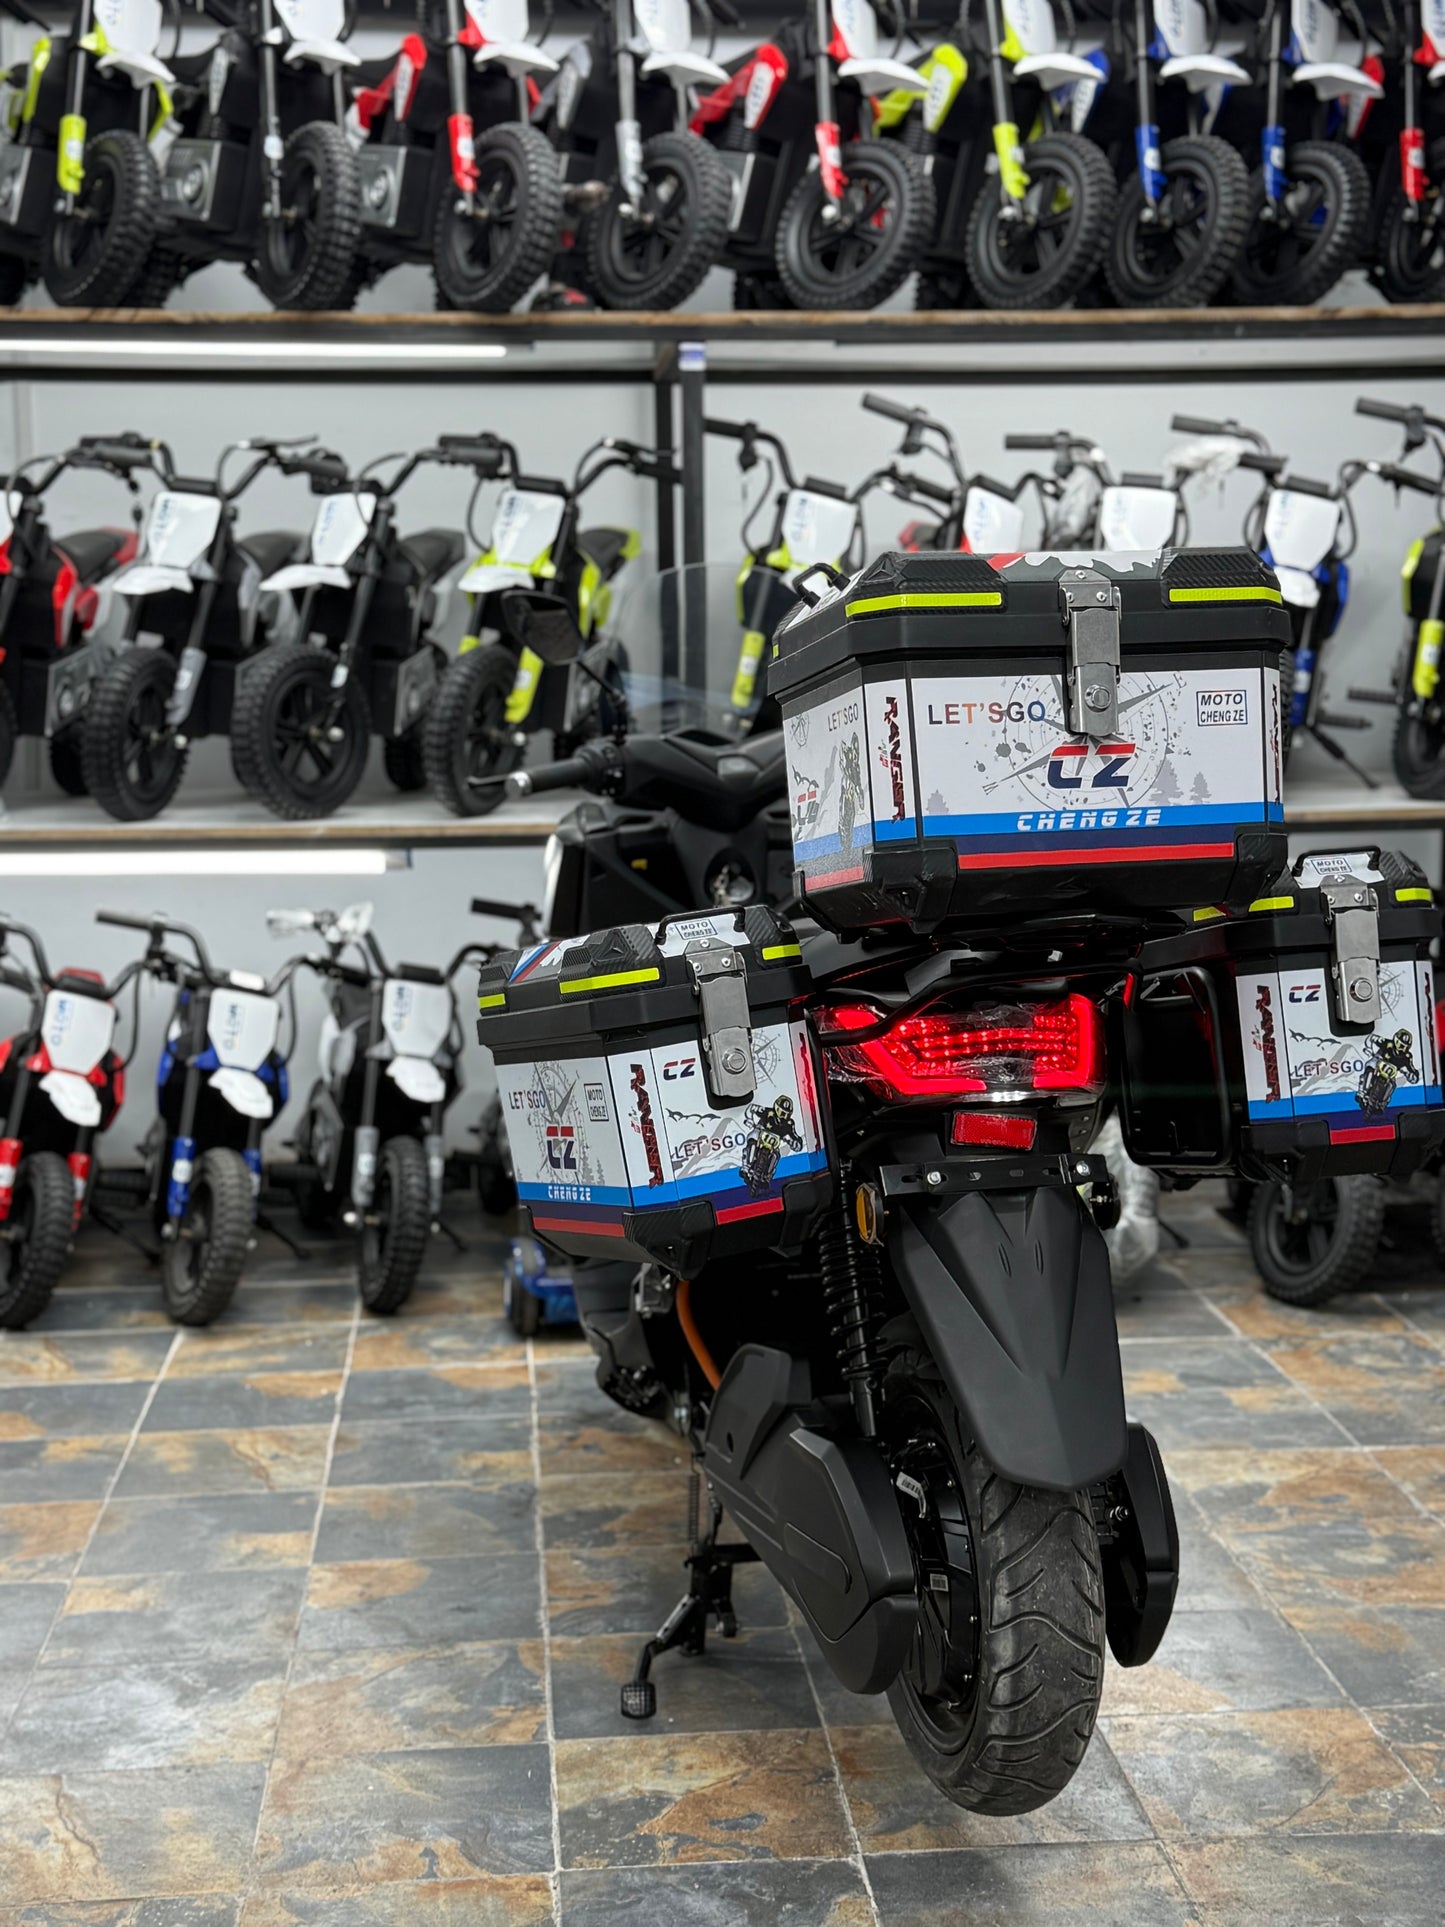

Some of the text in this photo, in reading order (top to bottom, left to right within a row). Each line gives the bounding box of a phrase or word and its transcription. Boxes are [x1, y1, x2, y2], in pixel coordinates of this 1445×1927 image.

[1200, 693, 1243, 706] MOTO
[884, 696, 906, 824] RANGER
[1047, 743, 1136, 789] CZ
[1016, 808, 1162, 831] CHENG ZE
[681, 921, 708, 931] MOTO
[1289, 984, 1321, 1003] CZ
[663, 1057, 696, 1081] CZ
[546, 1126, 577, 1169] CZ
